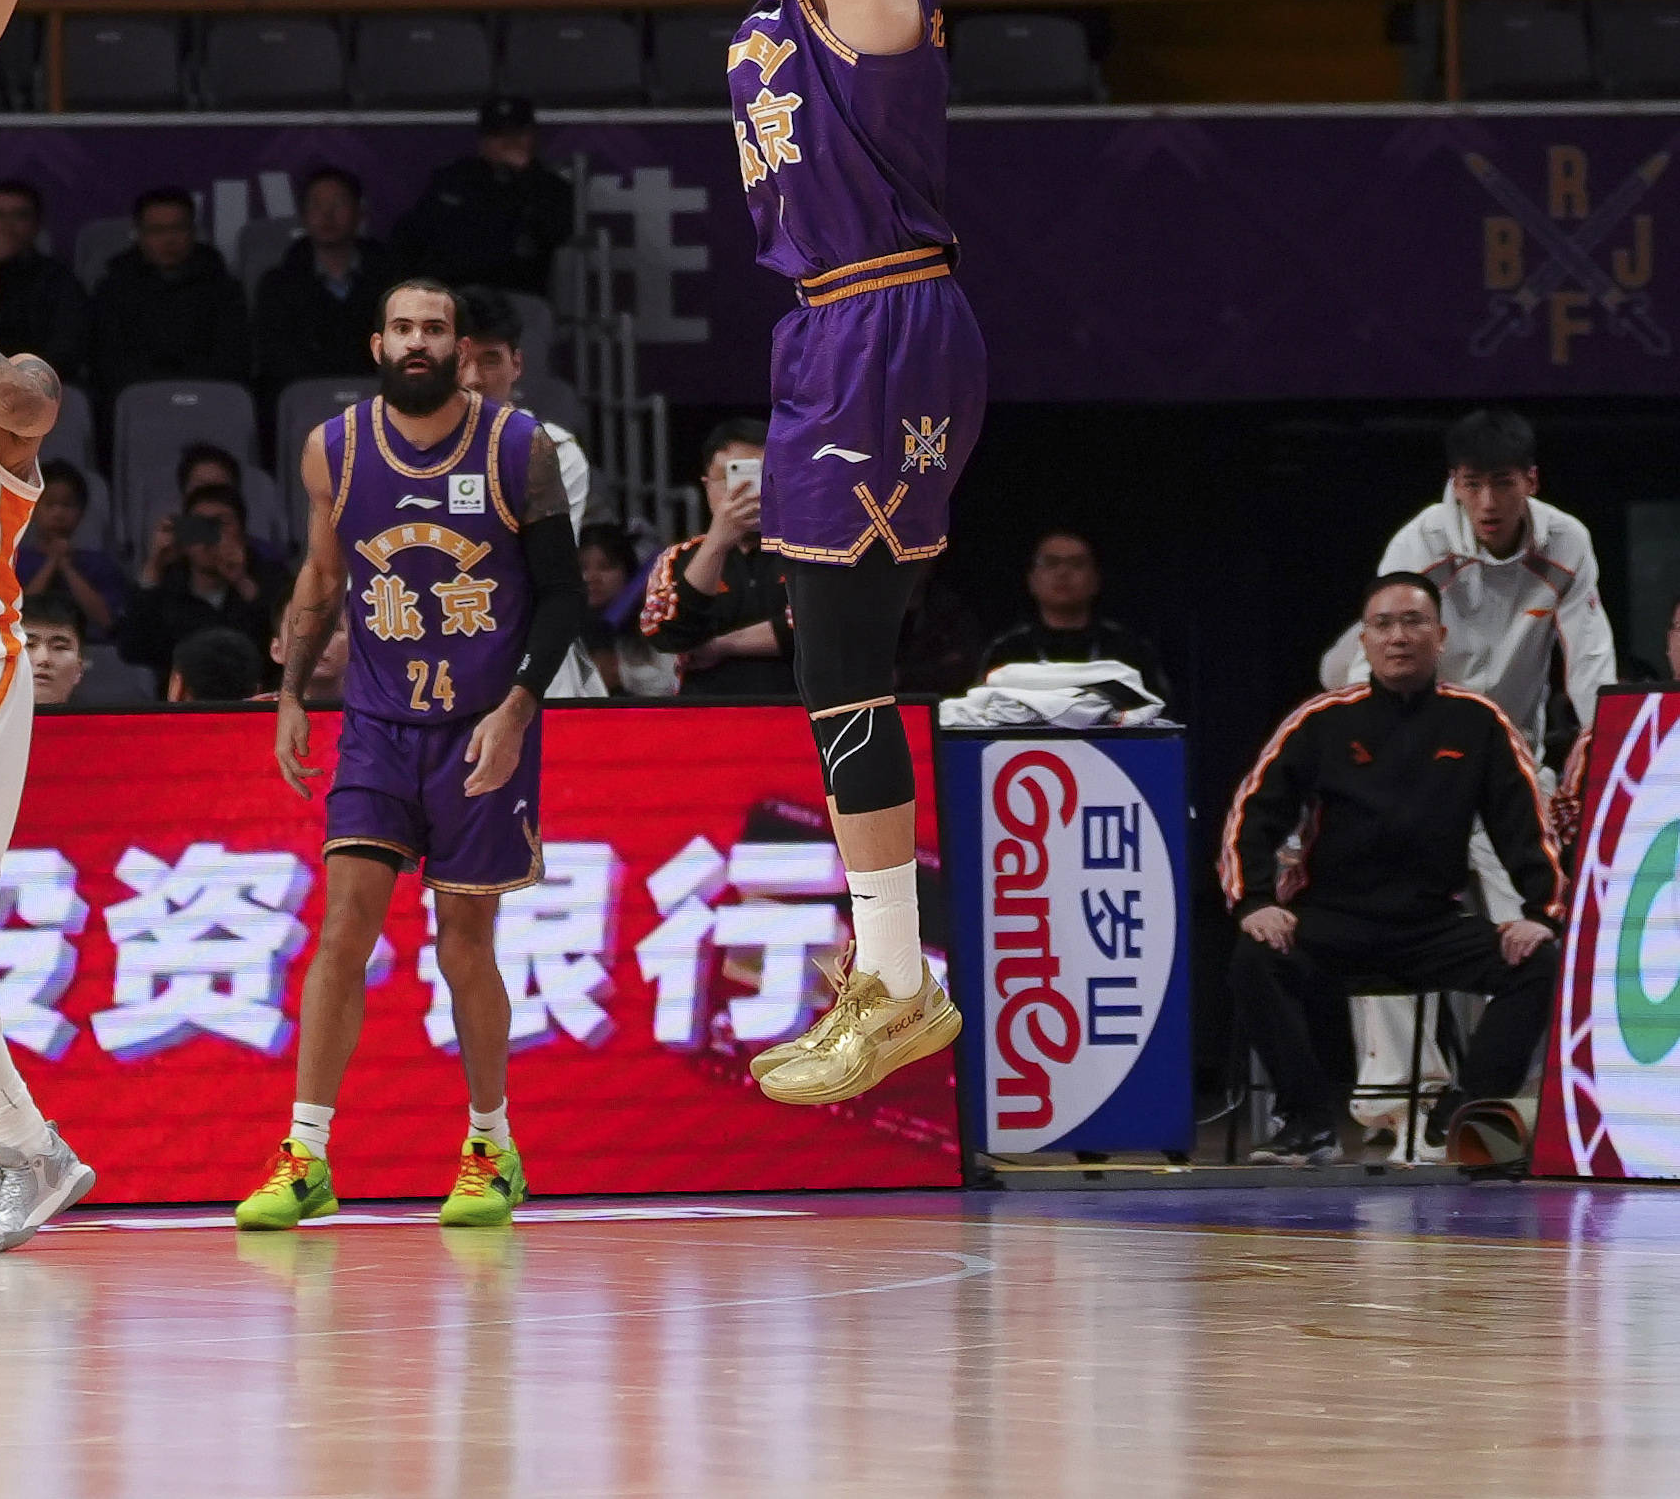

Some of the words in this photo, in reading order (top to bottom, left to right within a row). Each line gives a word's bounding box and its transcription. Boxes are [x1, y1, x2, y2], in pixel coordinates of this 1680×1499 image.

[361, 573, 499, 641] 北京
[406, 660, 456, 713] 24
[991, 749, 1081, 1131] Ganten
[1081, 801, 1144, 1047] 百岁山
